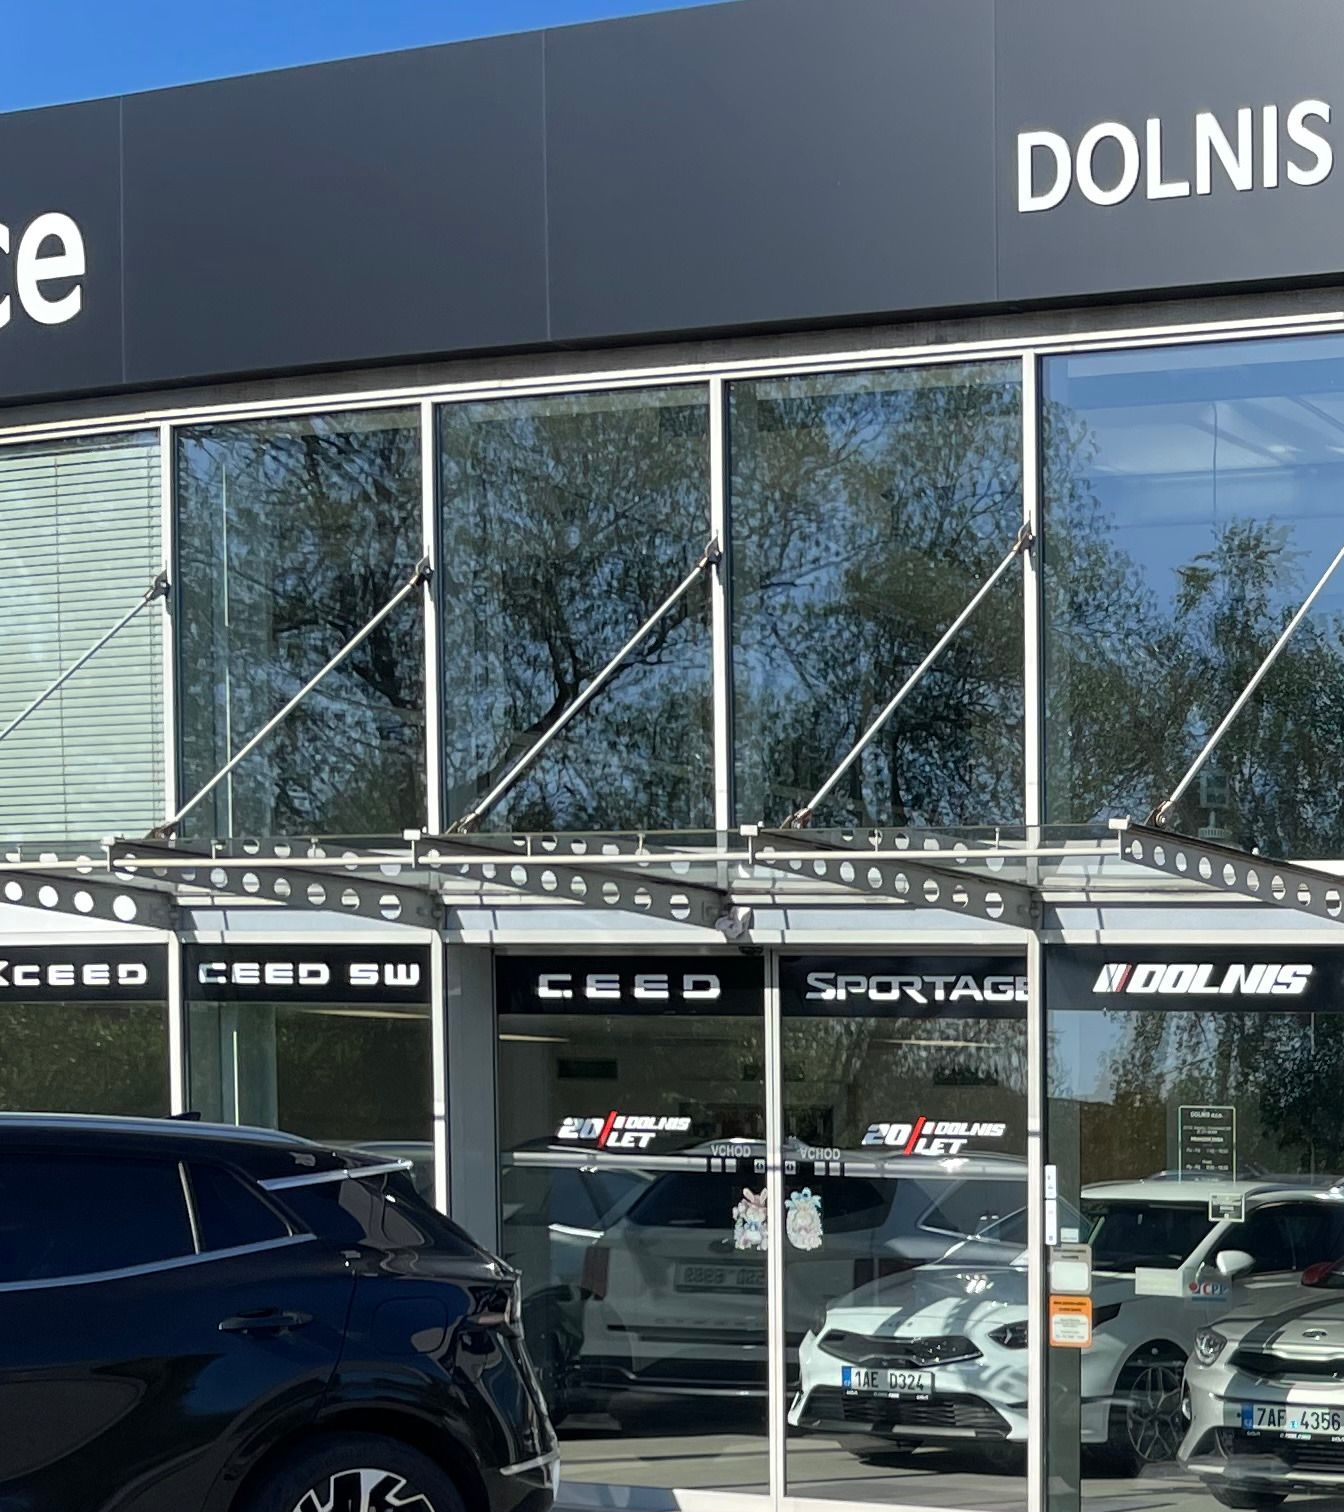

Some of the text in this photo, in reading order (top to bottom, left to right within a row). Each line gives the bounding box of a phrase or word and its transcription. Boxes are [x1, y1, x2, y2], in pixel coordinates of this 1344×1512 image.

[1018, 99, 1333, 213] DOLNIS
[199, 962, 420, 986] CEED SW
[1125, 963, 1313, 994] DOLNIS
[538, 974, 721, 998] CEED
[557, 1116, 691, 1140] 20 DOLNIS
[606, 1131, 656, 1148] LET
[861, 1122, 1006, 1146] 20 DOLNIS
[711, 1145, 751, 1158] VCHOD
[800, 1147, 841, 1160] VCHOD
[914, 1137, 967, 1156] LET
[855, 1371, 925, 1392] 1AE D324
[1300, 1410, 1342, 1432] 4356
